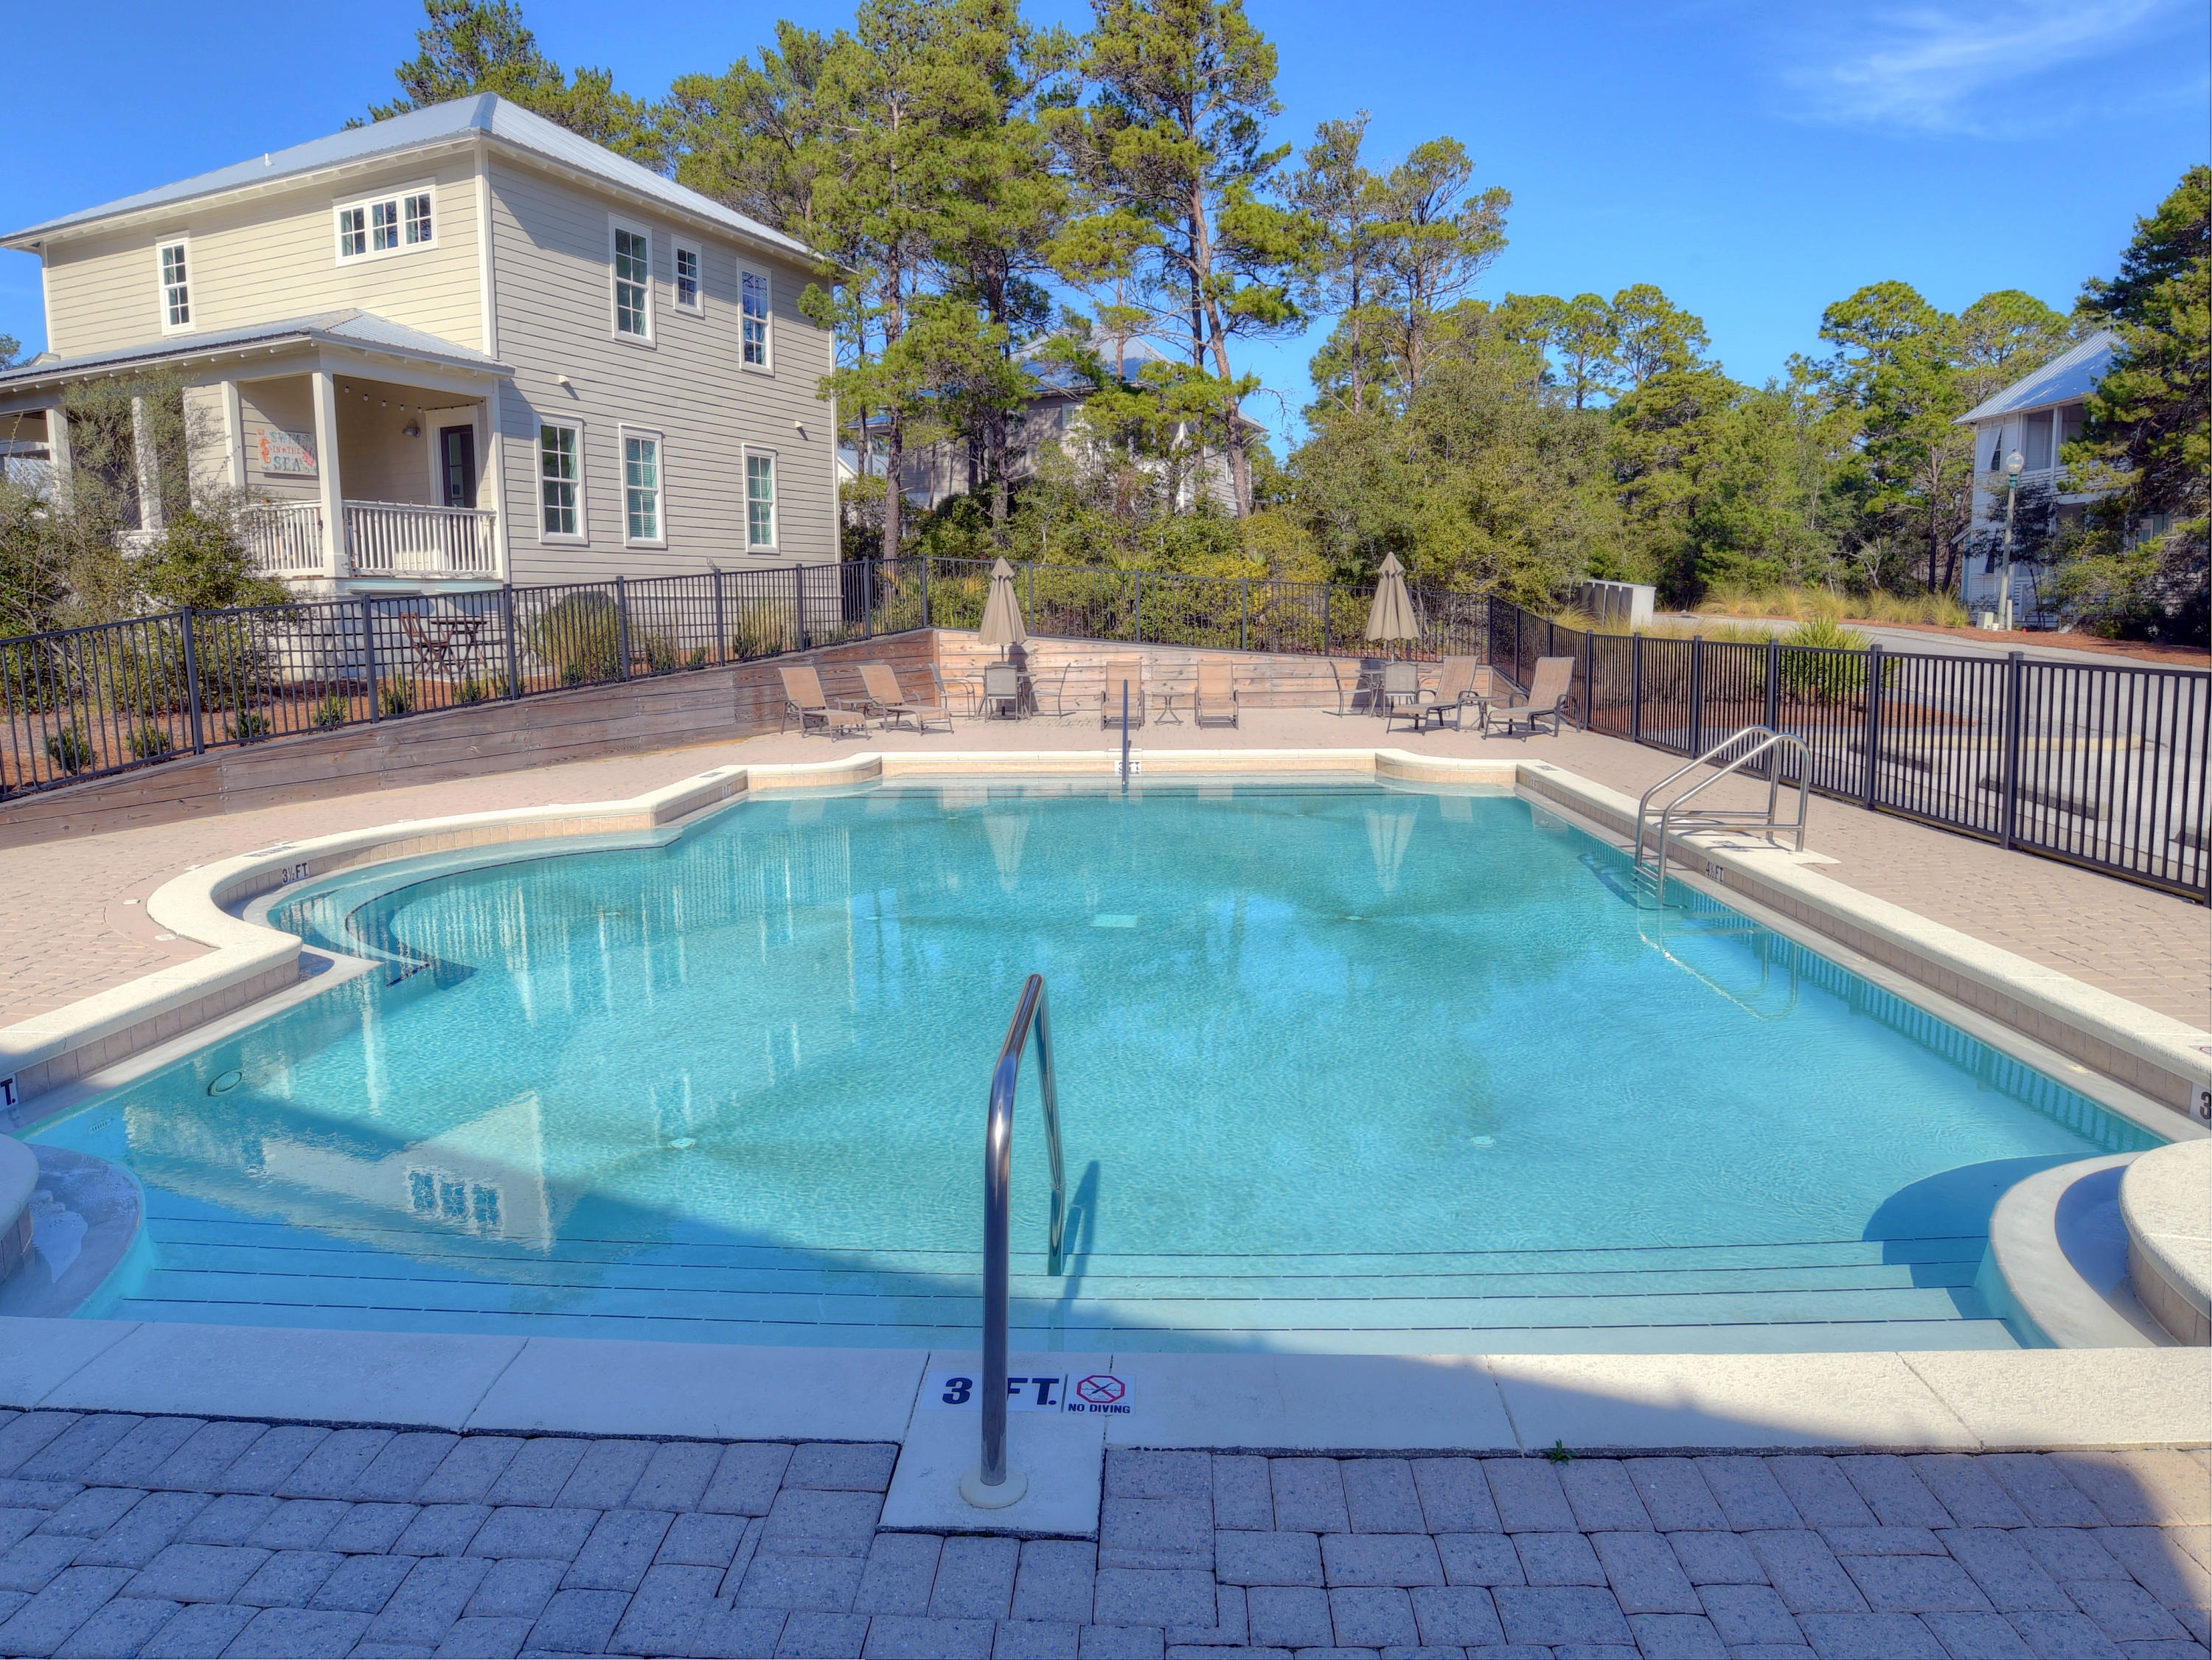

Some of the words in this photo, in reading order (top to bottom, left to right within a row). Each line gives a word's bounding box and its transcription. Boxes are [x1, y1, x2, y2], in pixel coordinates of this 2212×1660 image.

[273, 445, 280, 454] IN
[286, 446, 302, 455] THE
[274, 456, 301, 472] SEA
[942, 1378, 973, 1405] 3
[1068, 1403, 1085, 1412] NO
[1089, 1404, 1131, 1414] DIVING
